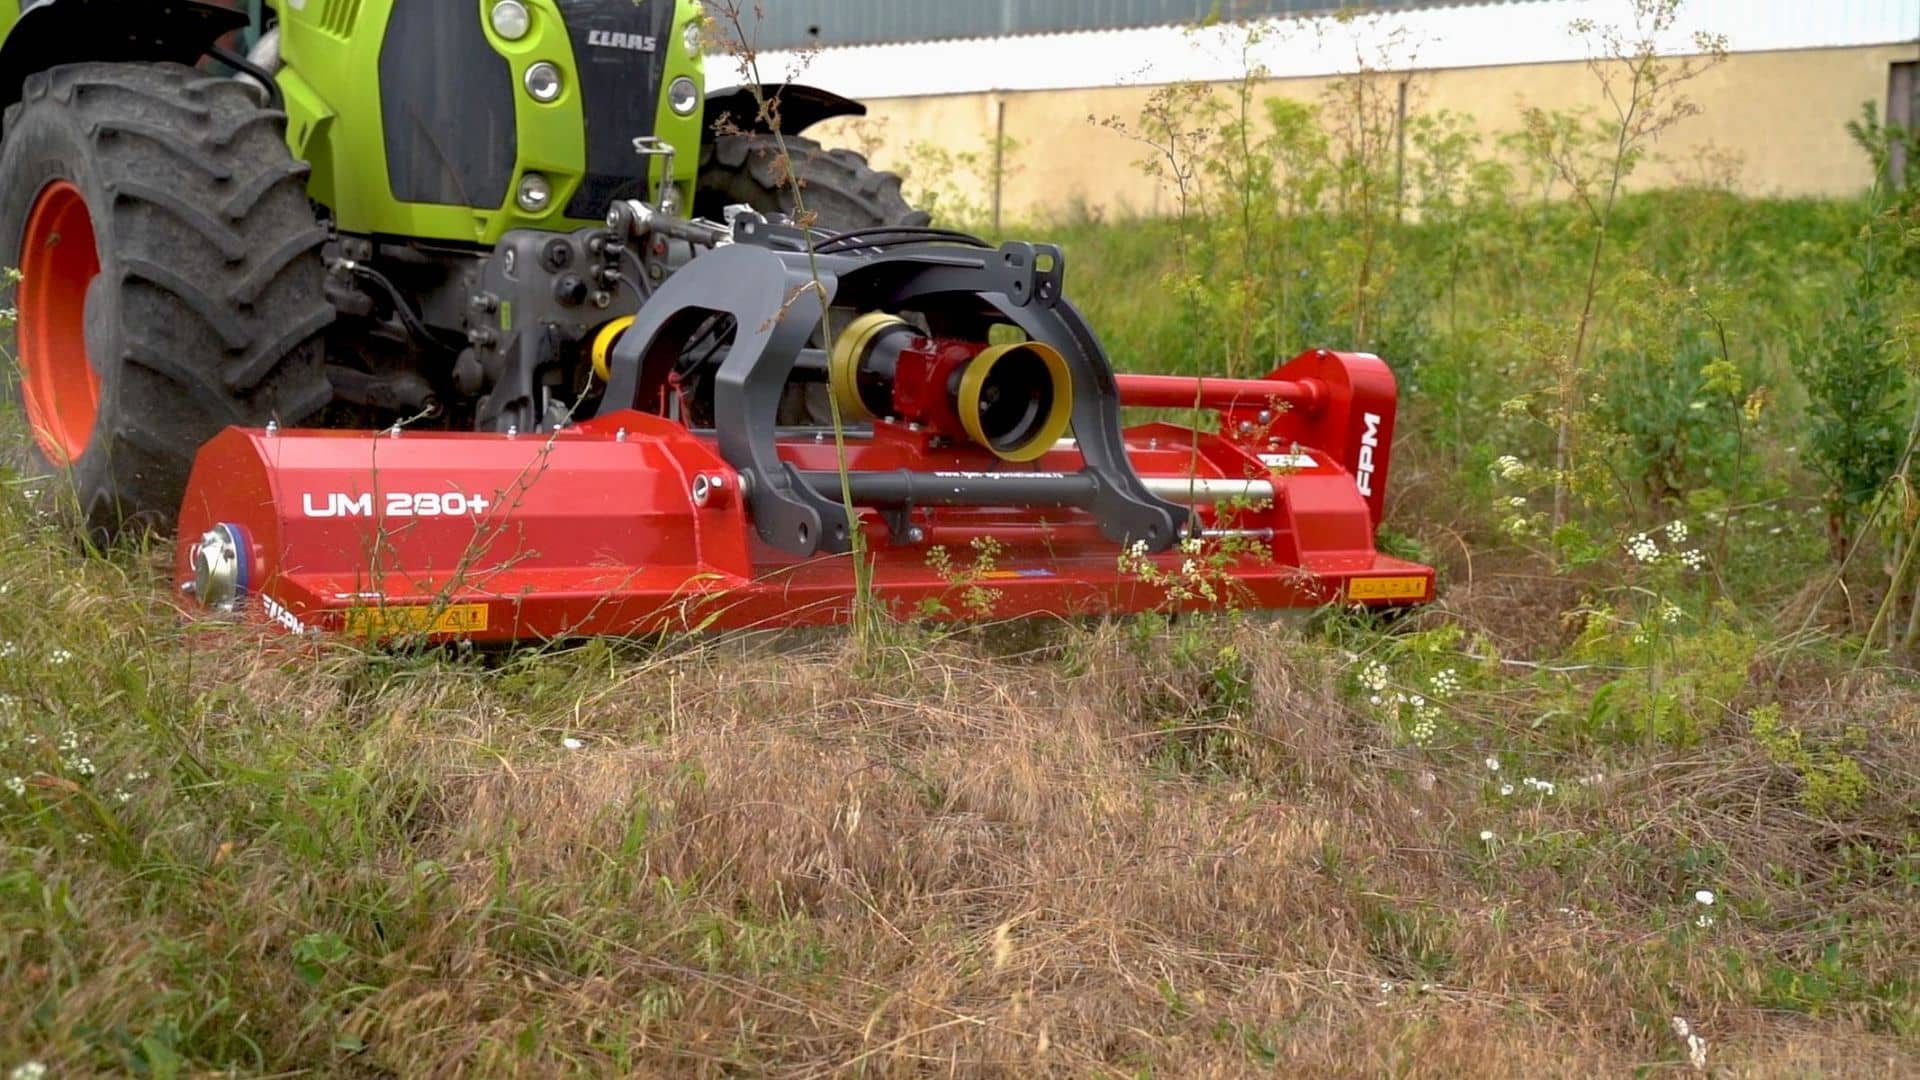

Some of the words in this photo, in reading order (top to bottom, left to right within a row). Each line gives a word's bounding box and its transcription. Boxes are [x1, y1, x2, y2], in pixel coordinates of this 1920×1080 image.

[588, 30, 656, 51] CLAAS
[1356, 411, 1381, 497] FPM
[303, 492, 372, 517] UM
[386, 492, 489, 517] 280+
